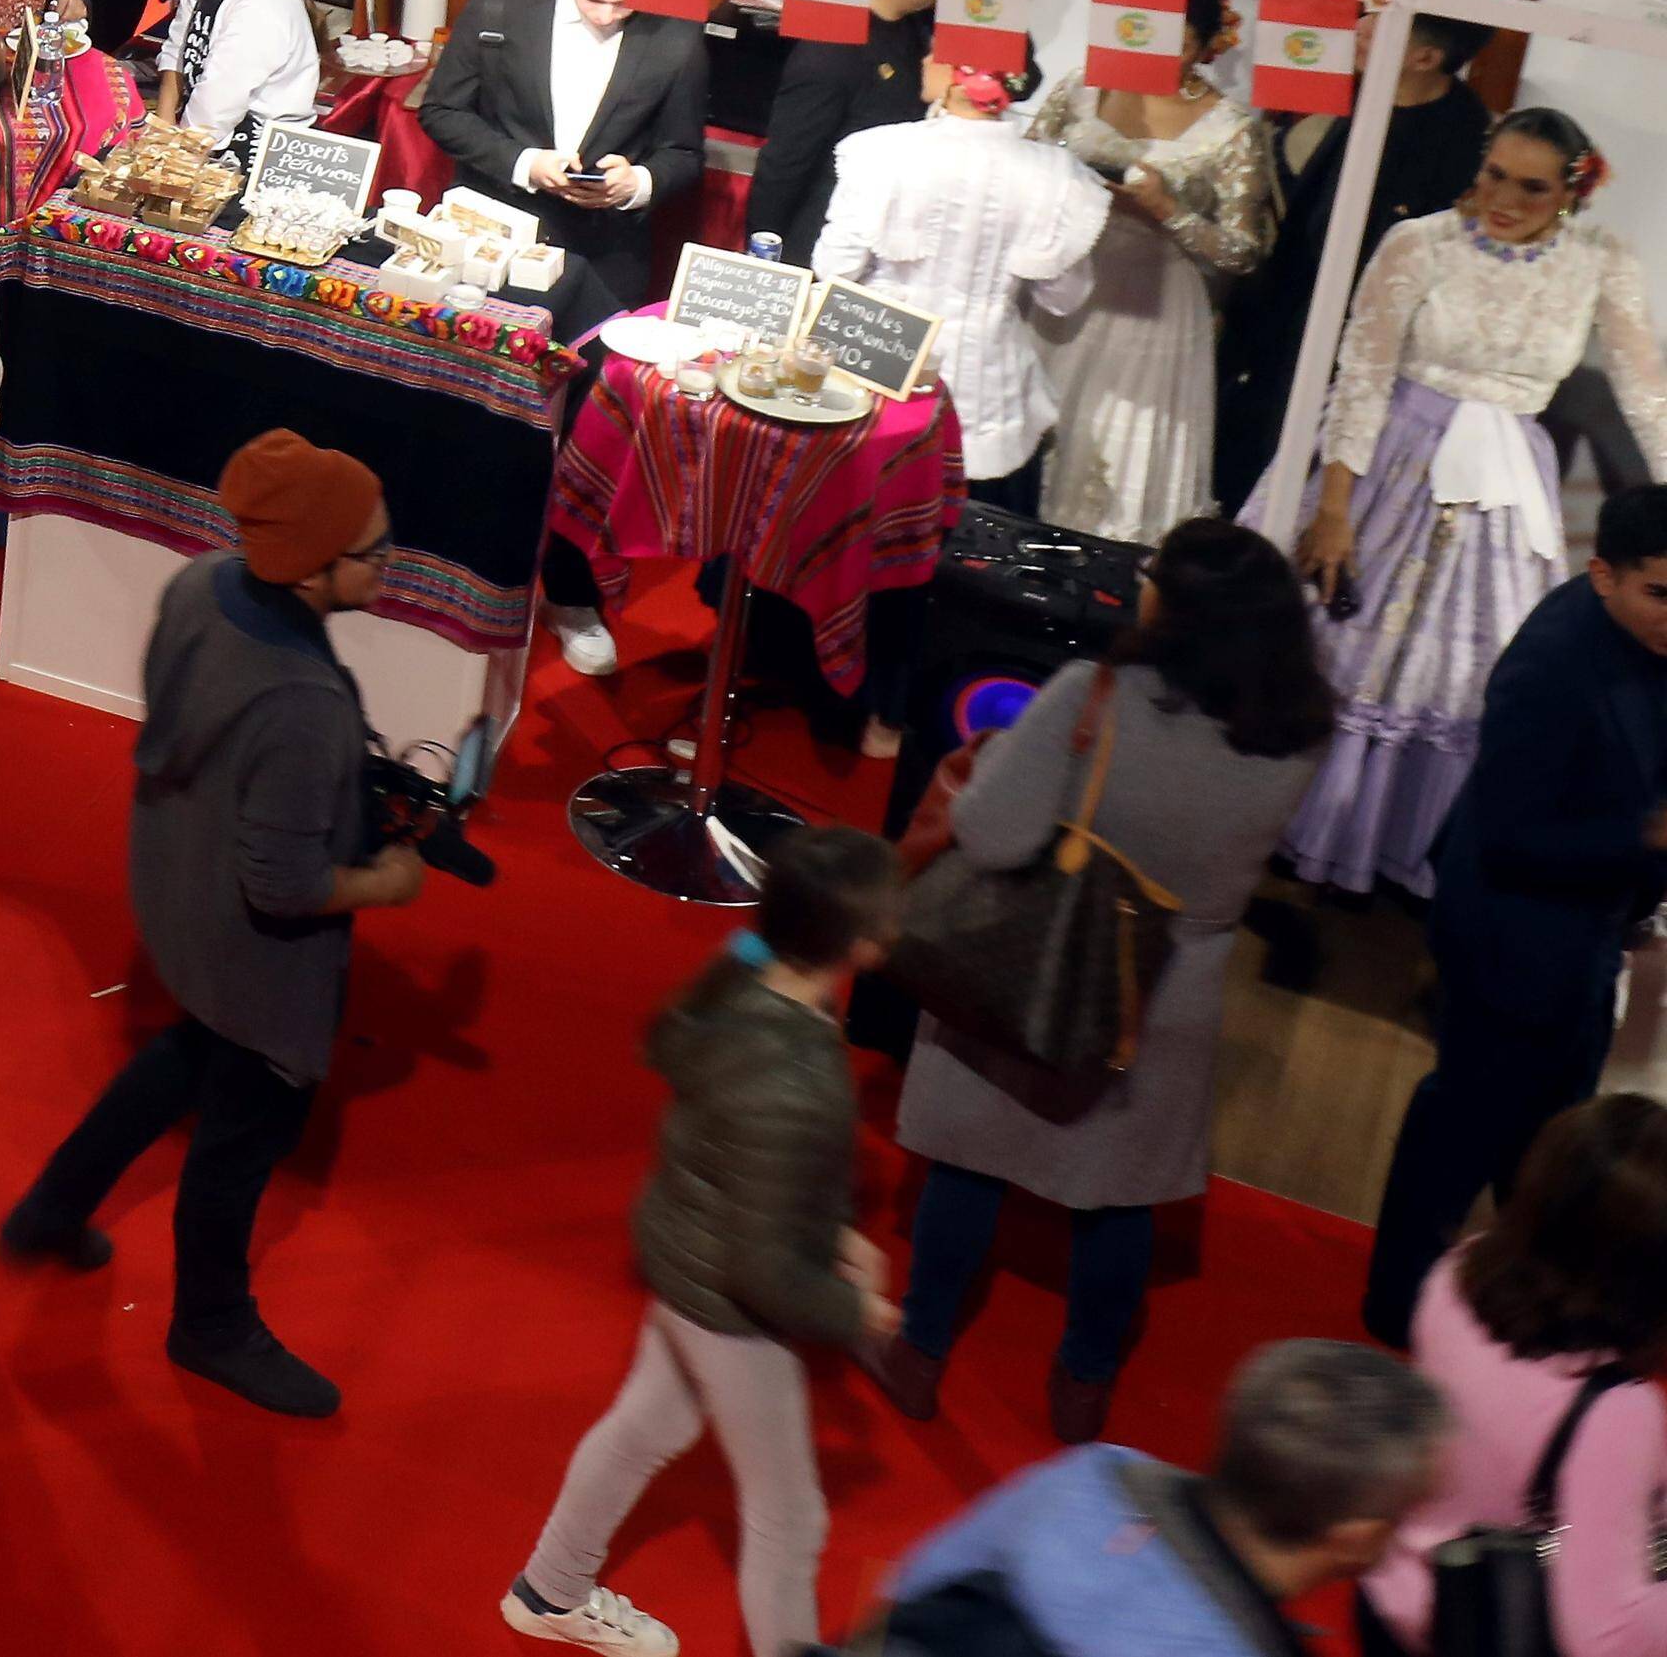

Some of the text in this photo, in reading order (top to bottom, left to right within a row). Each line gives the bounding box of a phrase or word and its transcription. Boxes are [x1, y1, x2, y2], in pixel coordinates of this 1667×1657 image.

[269, 132, 349, 163] Desserts
[818, 311, 839, 332] de
[832, 292, 903, 334] Tamales
